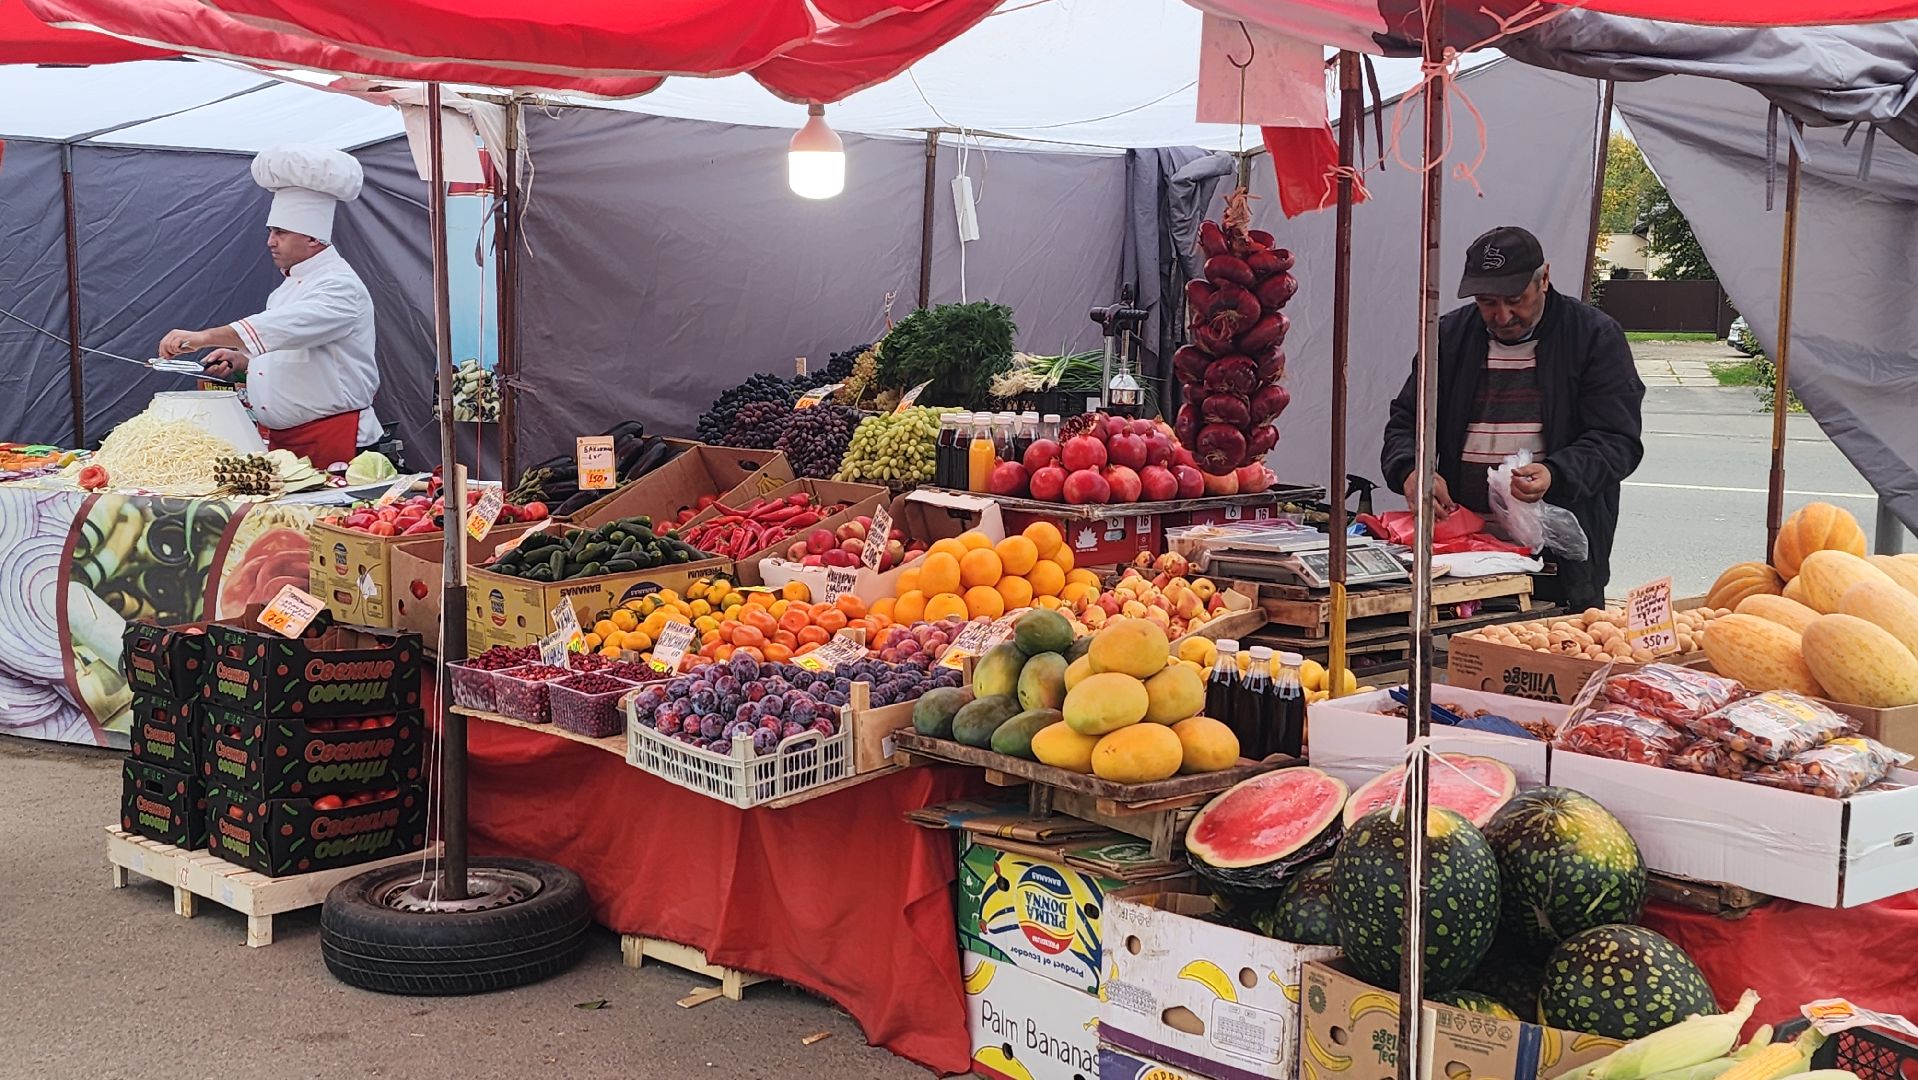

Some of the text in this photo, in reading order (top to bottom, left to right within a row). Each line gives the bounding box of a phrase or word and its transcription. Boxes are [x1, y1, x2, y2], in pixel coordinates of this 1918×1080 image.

[1139, 515, 1149, 526] 16
[1230, 505, 1237, 517] 6
[1259, 509, 1267, 521] 16
[560, 584, 601, 597] BANANAS
[267, 613, 284, 624] 70
[1643, 634, 1661, 649] 350
[304, 658, 395, 682] Свежие
[1503, 666, 1559, 696] Village
[308, 681, 389, 705] овощи
[304, 738, 395, 763] Свежие
[307, 759, 389, 784] овощи
[310, 808, 400, 840] Свежие
[314, 828, 395, 859] овощи
[1031, 871, 1062, 887] BANANAS
[1024, 890, 1068, 916] DONNA
[1026, 904, 1068, 931] PRIMA
[1010, 946, 1084, 978] Product of Ecuador
[981, 999, 1019, 1043] Palm
